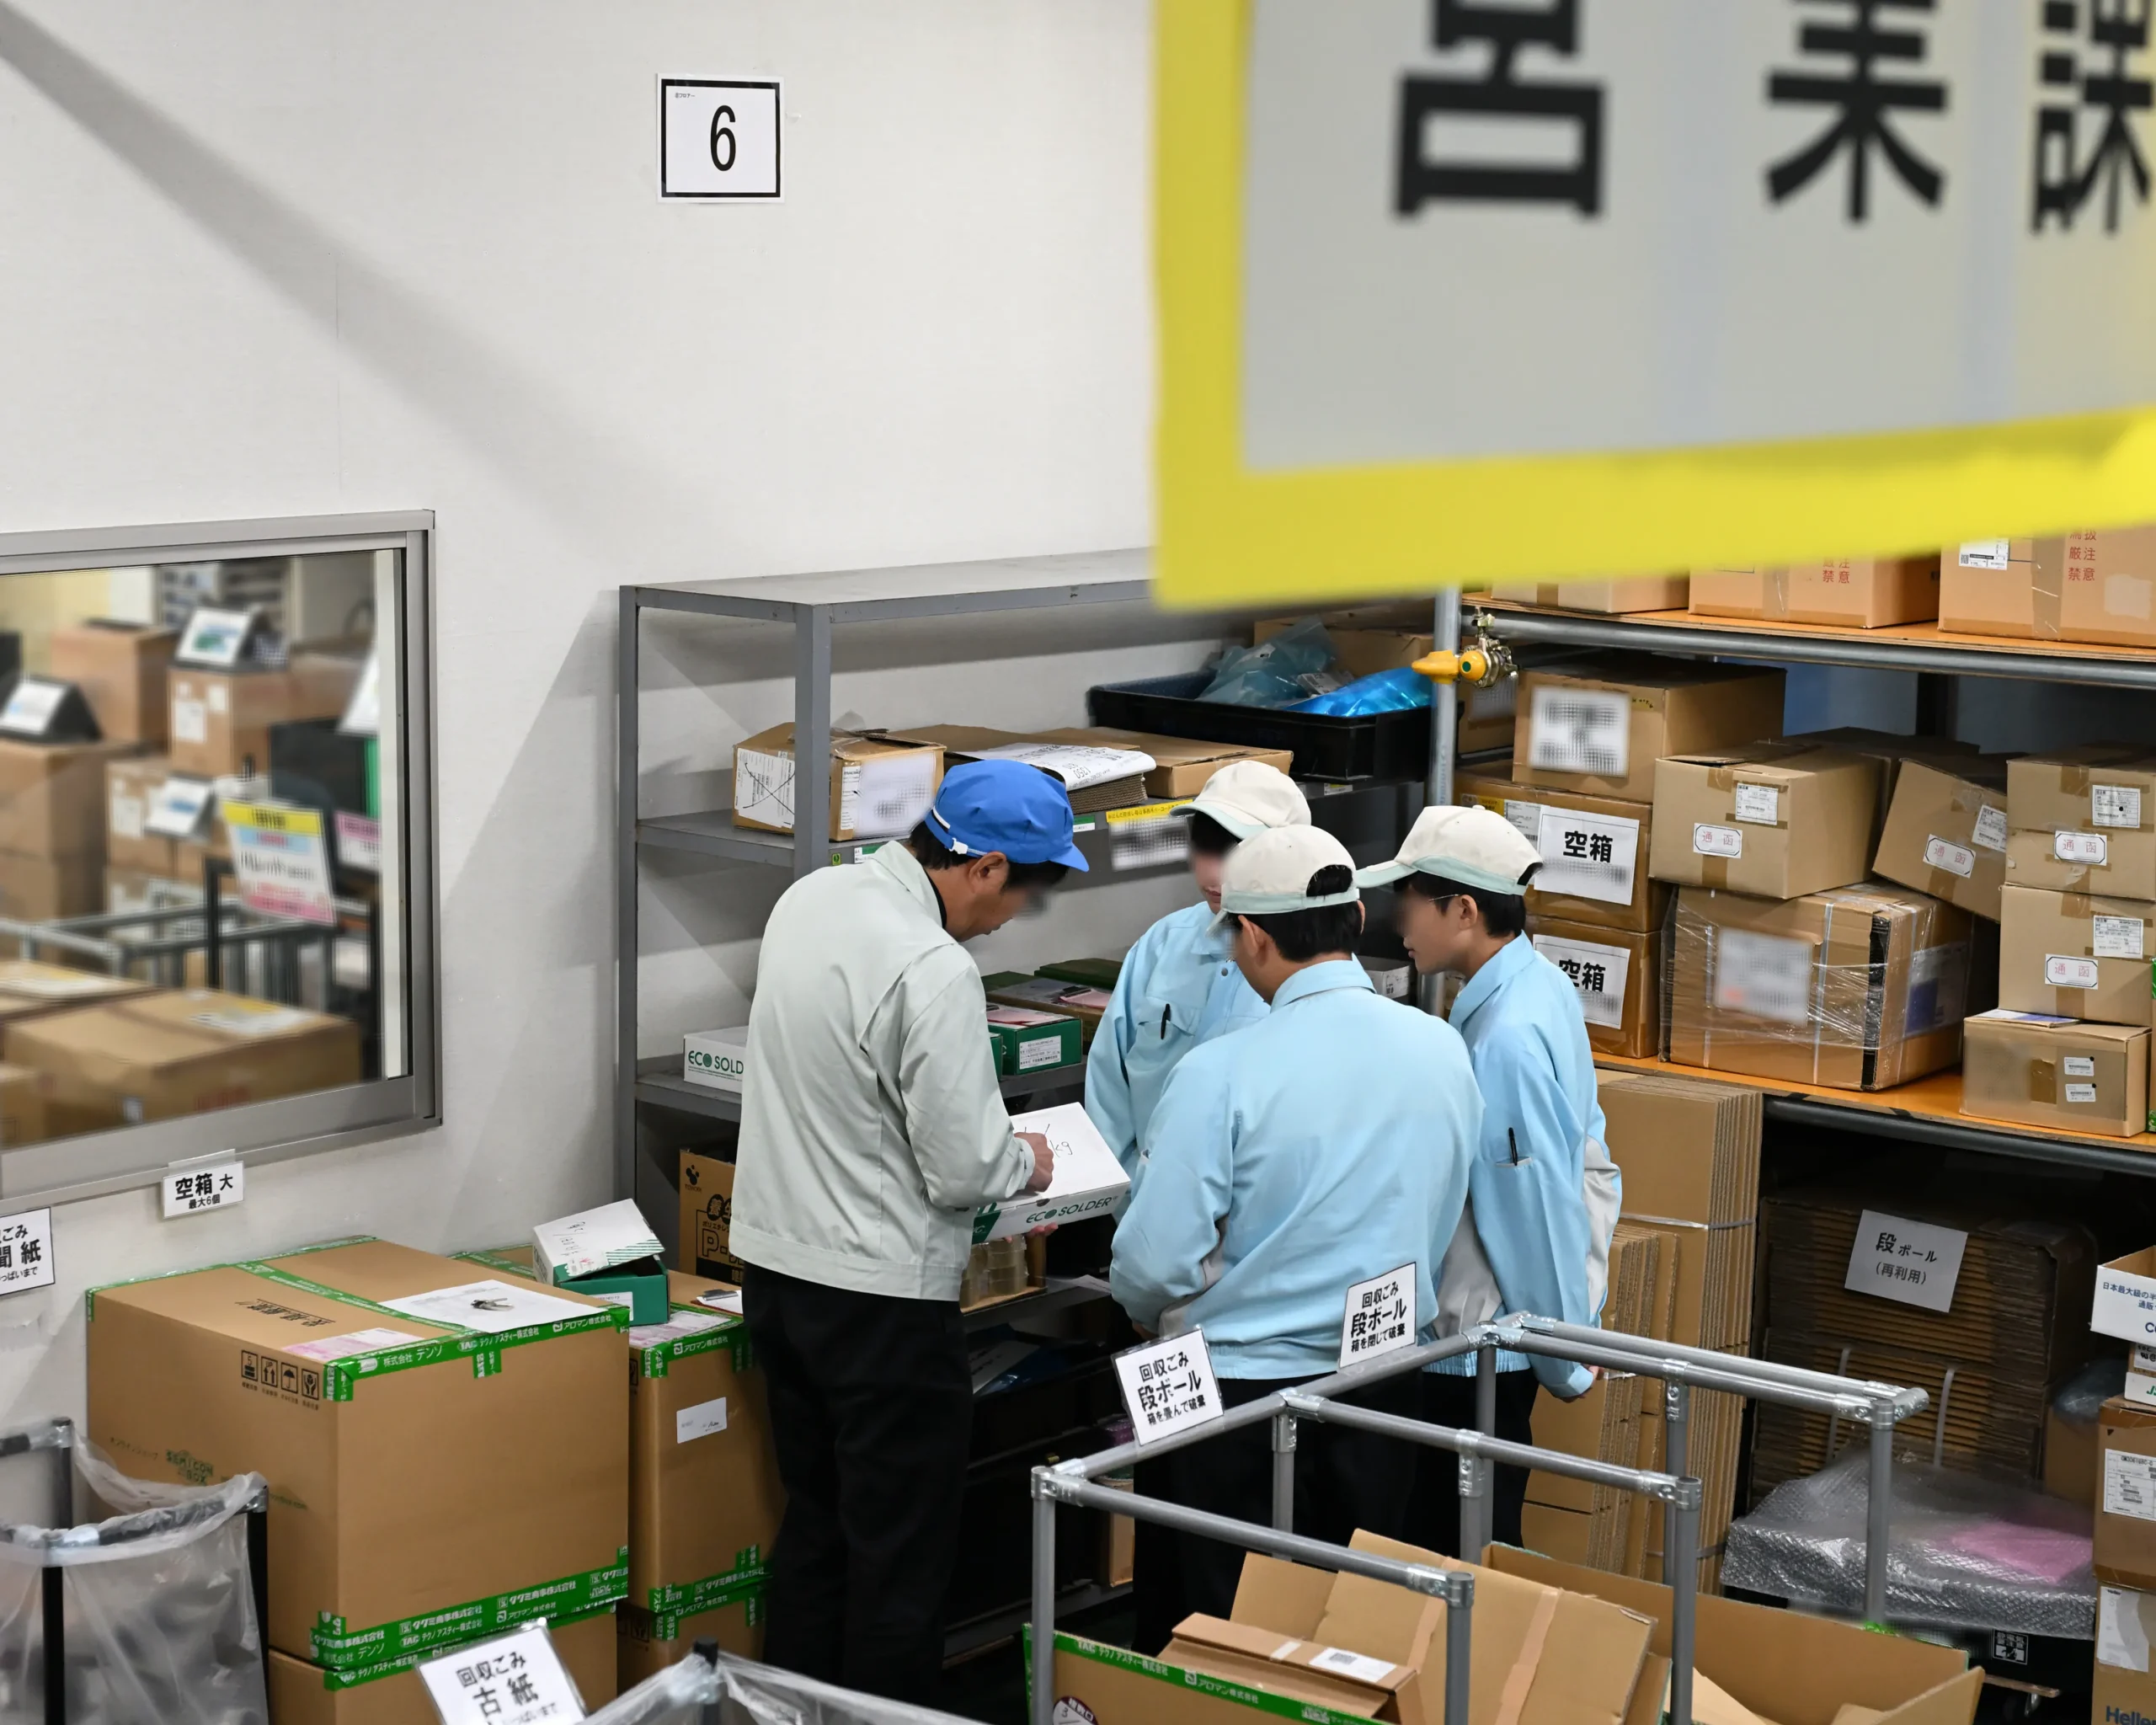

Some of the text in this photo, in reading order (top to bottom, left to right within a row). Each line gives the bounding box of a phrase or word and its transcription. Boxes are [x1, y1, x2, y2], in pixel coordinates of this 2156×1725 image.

[710, 105, 736, 171] 6
[1562, 830, 1614, 864] 空箱
[1558, 959, 1607, 992] 空箱
[688, 1050, 712, 1068] ECO
[175, 1173, 233, 1201] 空箱 大
[189, 1194, 221, 1210] 最大6個
[1026, 1197, 1113, 1224] ECO SOLDER
[0, 1224, 28, 1243] ごみ
[1876, 1232, 1937, 1263] 段ボール
[1361, 1280, 1400, 1309] 回収ごみ
[2138, 1300, 2156, 1311] 通販
[1350, 1298, 1407, 1338] 段ボール
[2145, 1322, 2156, 1333] C
[1351, 1322, 1406, 1354] 箱を閉じて破棄
[383, 1354, 413, 1368] 株式会社
[1139, 1351, 1189, 1382] 回収ごみ
[1137, 1370, 1202, 1412] 段ボール
[1146, 1396, 1207, 1425] 箱を畳んで破棄
[456, 1651, 526, 1688] 回収ごみ
